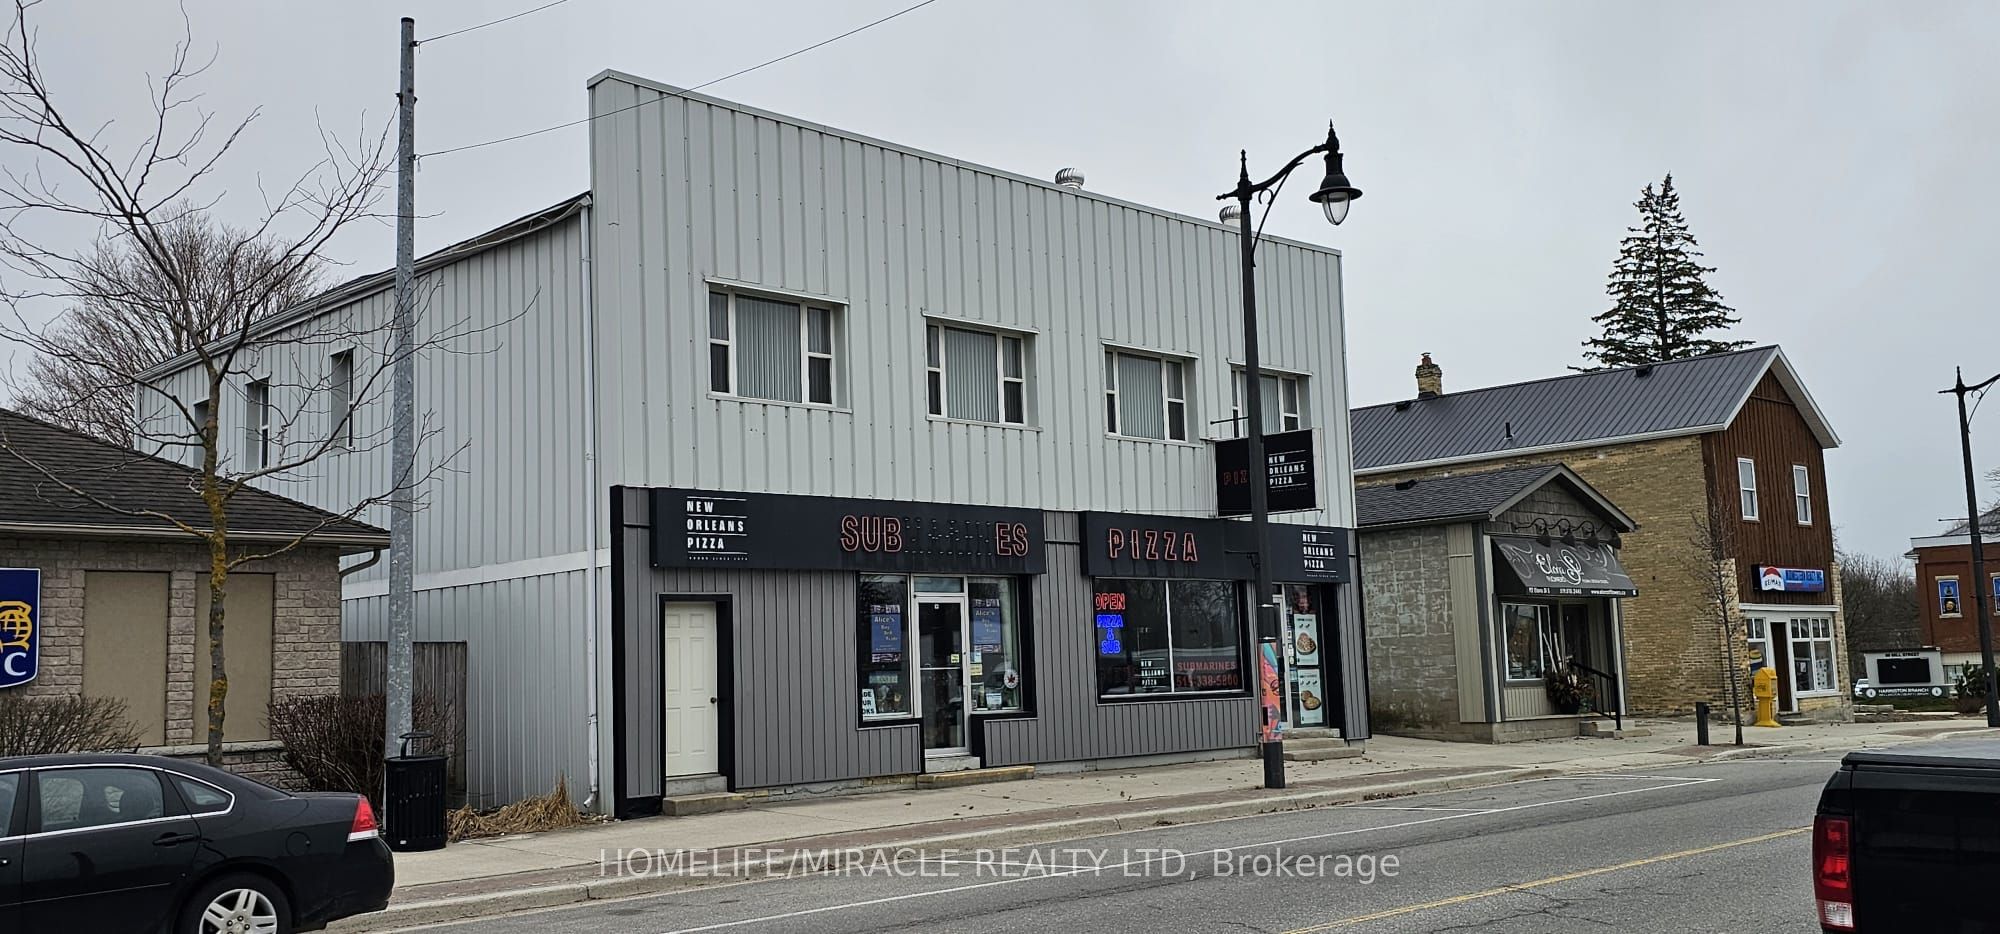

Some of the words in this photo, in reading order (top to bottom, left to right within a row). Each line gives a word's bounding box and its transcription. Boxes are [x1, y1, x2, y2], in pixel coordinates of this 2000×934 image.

[1268, 455, 1285, 464] NEW
[1269, 463, 1305, 475] ORLEANS
[1269, 476, 1293, 486] PIZZA
[686, 500, 714, 513] NEW
[686, 518, 744, 532] ORLEANS
[687, 537, 725, 550] PIZZA
[1302, 533, 1317, 543] NEW
[1108, 527, 1199, 562] PIZZA
[1303, 546, 1334, 556] ORLEANS
[1304, 559, 1324, 569] PIZZA
[1096, 593, 1125, 610] OPEN
[1097, 614, 1124, 628] PIZZA
[1102, 640, 1120, 654] SUB
[1176, 660, 1237, 672] SUBMARINES
